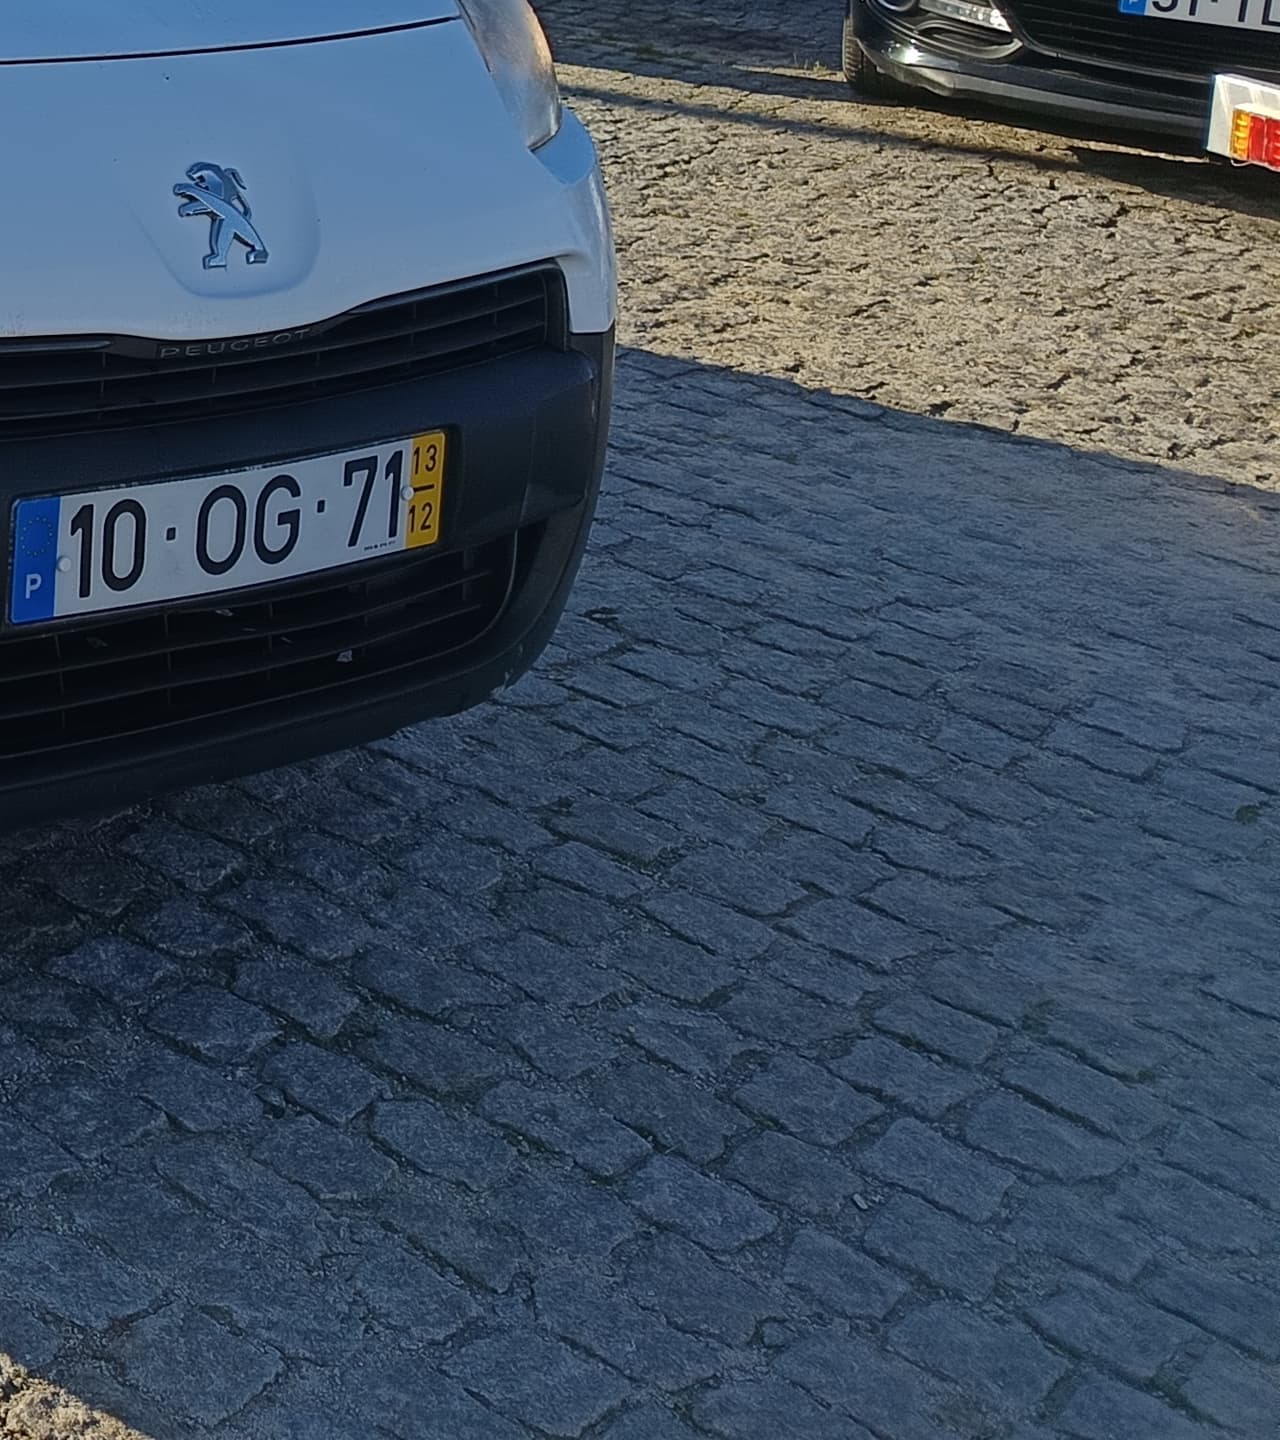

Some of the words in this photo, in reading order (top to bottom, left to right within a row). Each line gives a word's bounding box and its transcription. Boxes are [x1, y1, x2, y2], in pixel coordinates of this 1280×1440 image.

[160, 328, 311, 359] PEUGEOT
[413, 443, 438, 476] 13
[408, 501, 433, 534] 12
[24, 572, 43, 600] P
